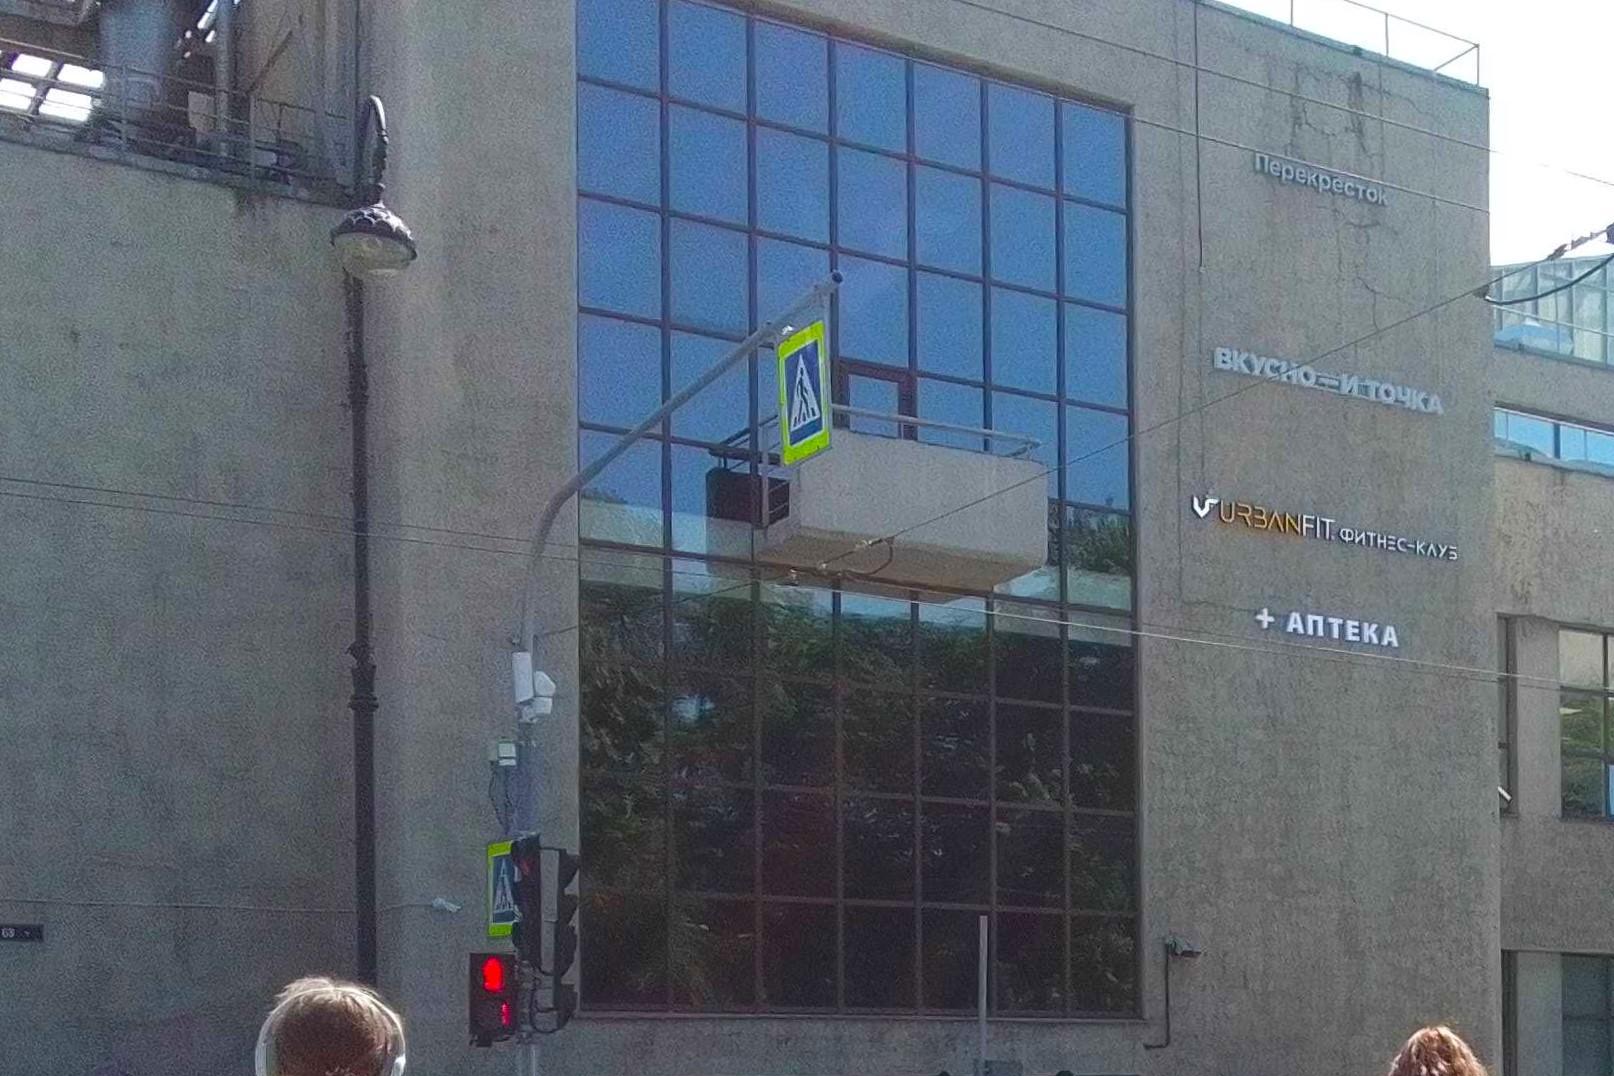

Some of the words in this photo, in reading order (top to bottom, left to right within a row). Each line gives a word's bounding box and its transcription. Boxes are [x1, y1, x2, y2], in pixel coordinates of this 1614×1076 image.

[1366, 379, 1444, 416] ТОЧКА
[1339, 527, 1458, 560] ФИТНЕС-КЛУБ
[1286, 611, 1399, 648] АПТЕКА
